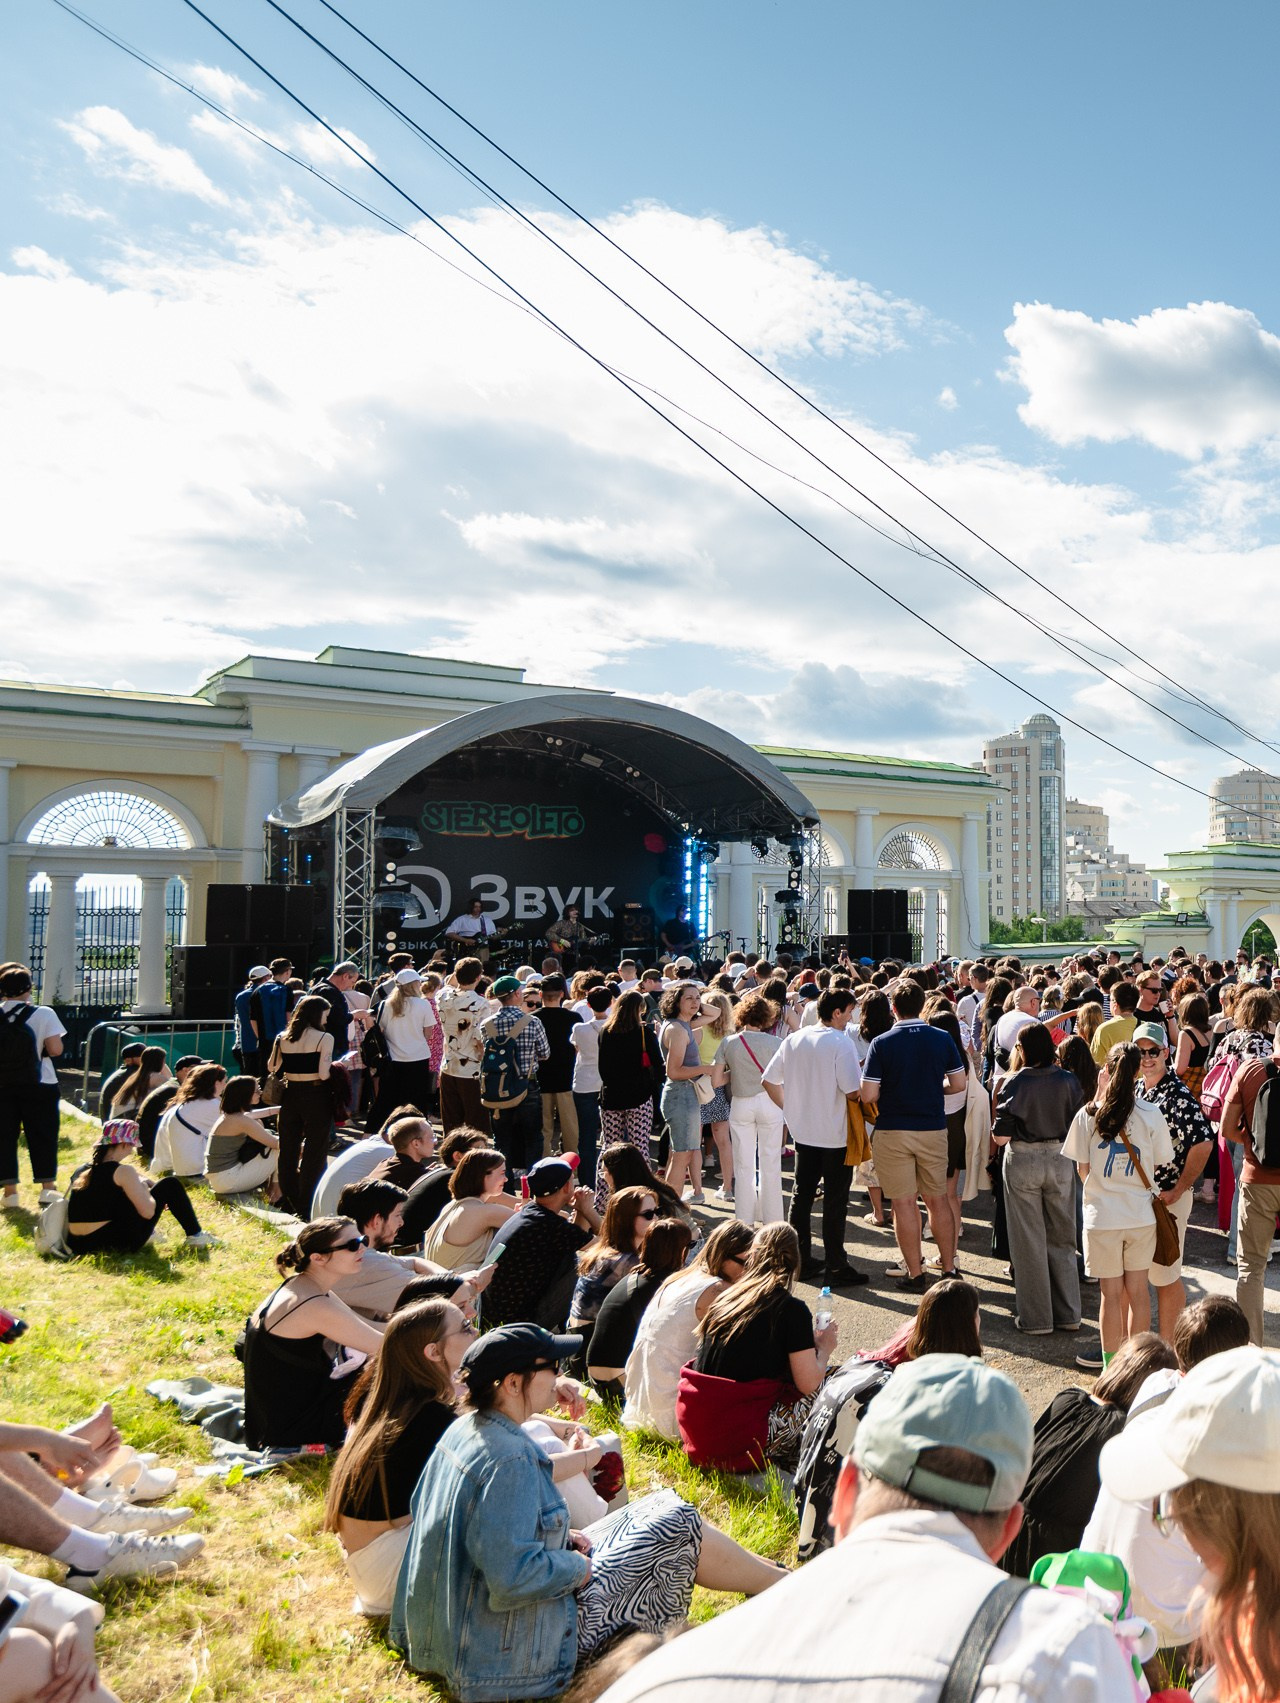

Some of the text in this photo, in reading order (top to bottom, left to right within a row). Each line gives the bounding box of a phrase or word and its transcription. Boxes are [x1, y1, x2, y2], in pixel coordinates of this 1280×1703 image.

[422, 801, 585, 839] STEREOLETO
[470, 874, 615, 920] Звук
[377, 941, 438, 949] МЗЫКА
